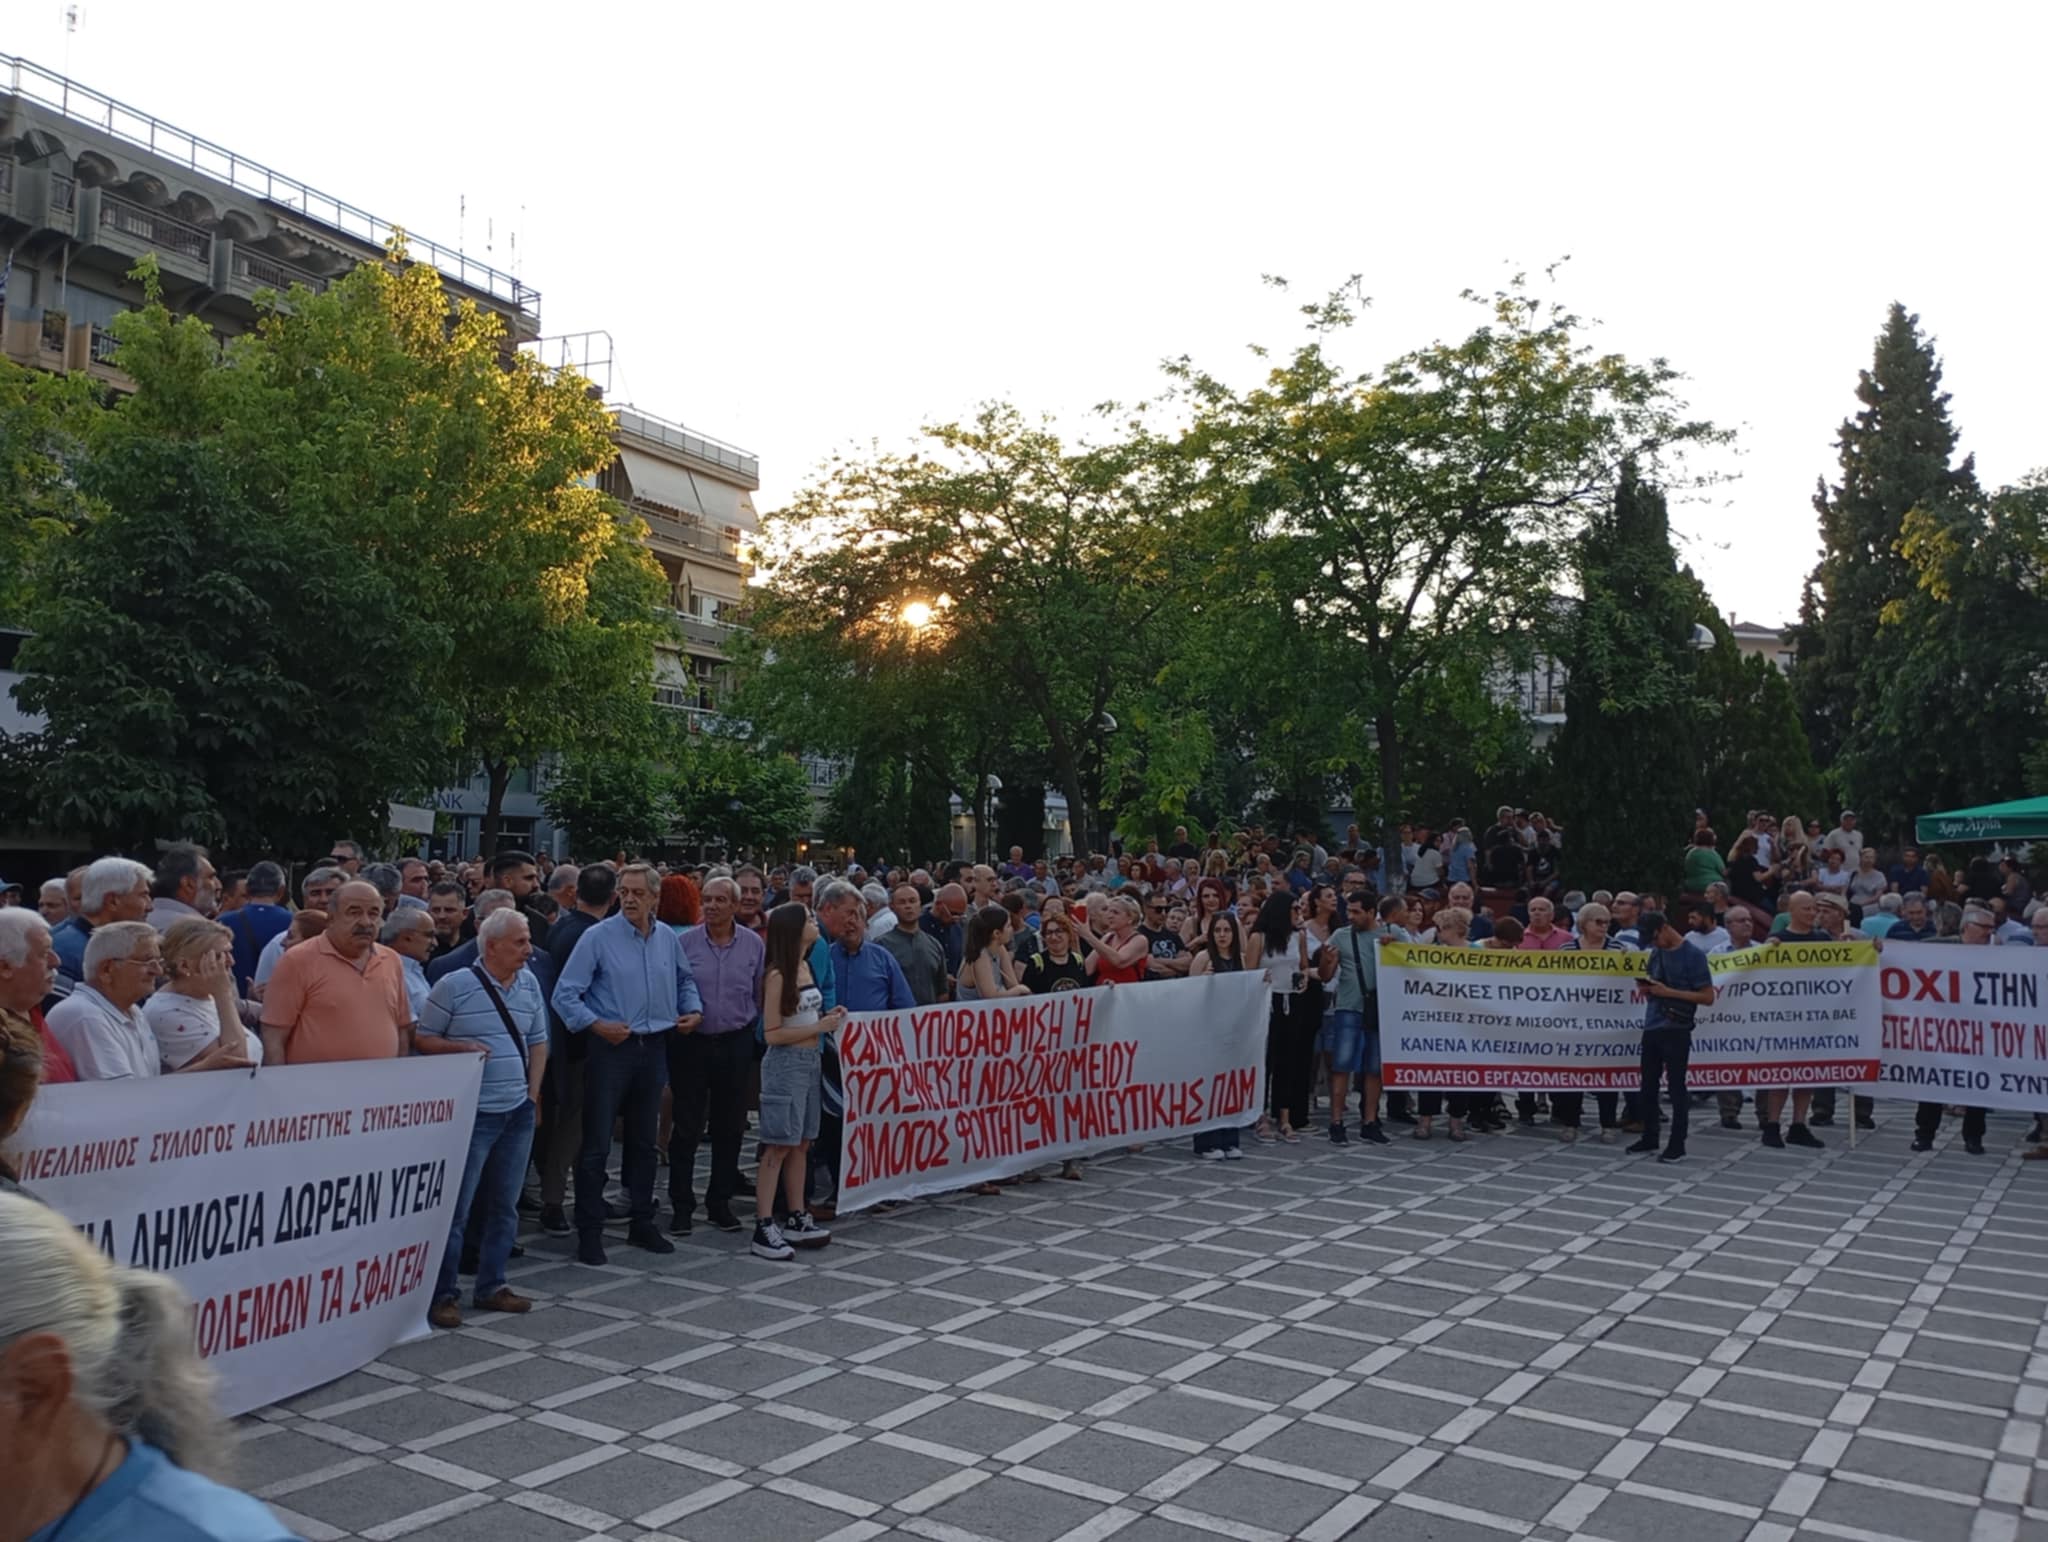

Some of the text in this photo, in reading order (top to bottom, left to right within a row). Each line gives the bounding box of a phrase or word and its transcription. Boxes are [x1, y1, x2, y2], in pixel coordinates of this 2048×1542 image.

[1405, 949, 1532, 969] ΑΠΟΚΛΕΙΣΤΙΚΑ
[1537, 955, 1618, 971] ΔΗΜΟΣΙΑ
[1623, 957, 1634, 971] &
[1709, 953, 1761, 972] ΥΓΕΙΑ
[1765, 949, 1792, 964] ΓΙΑ
[1797, 947, 1854, 963] ΟΛΟΥΣ
[1404, 979, 1493, 1000] ΜΑΖΙΚΕΣ
[1499, 985, 1625, 1004] ΠΡΟΣΛΗΨΕΙΣ
[1727, 979, 1854, 998] ΠΡΟΣΩΠΙΚΟΥ
[1880, 967, 2037, 1008] ΟΧΙ ΣΤΗΝ
[841, 1015, 907, 1068] ΚΑΜΙΑ
[911, 1000, 1065, 1059] ΥΠΟΒΑΘΜΙΣΗ
[1401, 1010, 1464, 1024] ΑΥΞΗΣΕΙΣ
[1468, 1013, 1512, 1027] ΣΤΟΥΣ
[1516, 1016, 1584, 1031] ΜΙΣΘΟΥΣ,
[1586, 1017, 1644, 1030] ΕΠΑΝΑΦ
[1751, 1010, 1803, 1024] ΕΝΤΑΞΗ
[1806, 1009, 1830, 1022] ΣΤΑ
[1833, 1007, 1857, 1021] ΒΑΕ
[1881, 1014, 2048, 1061] ΣΤΕΛΕΧΩΣΗ ΤΟΥ Ν
[1401, 1037, 1467, 1052] ΚΑΝΕΝΑ
[1472, 1039, 1553, 1055] ΚΛΕΙΣΙΜΟ
[1574, 1043, 1644, 1057] ΣΥΓΧΩΝΕ
[1689, 1035, 1859, 1055] ΛΙΝΙΚΩΝ/ΤΜΗΜΑΤΩΝ
[977, 1040, 1138, 1106] ΝΟΣΟΚΟΜΕΙΟΥ
[1394, 1068, 1479, 1085] ΣΩΜΑΤΕΙΟ
[1484, 1070, 1606, 1087] ΕΡΓΑΖΟΜΕΝΩΝ
[1747, 1065, 1867, 1083] ΝΟΣΟΚΟΜΕΙΟΥ
[1878, 1063, 1990, 1091] ΣΩΜΑΤΕΙΟ
[150, 1123, 236, 1162] ΣΥΛΛΟΓΟΣ
[244, 1110, 353, 1148] ΑΛΛΗΛΕΓΓΥΗΣ
[361, 1098, 455, 1134] ΣΥΝΤΑΞΙΟΥΧΩΝ
[955, 1096, 1057, 1163] ΦΟΙΤΗΤΩΝ
[1063, 1077, 1204, 1143] ΜΑΙΕΥΤΙΚΗΣ
[1207, 1066, 1256, 1120] ΠΔΜ
[130, 1191, 265, 1271] ΔΗΜΟΣΙΑ
[273, 1171, 383, 1244] ΔΩΡΕΑΝ
[391, 1159, 447, 1219] ΥΓΕΙΑ
[319, 1265, 344, 1324] ΤΑ
[349, 1241, 431, 1316] ΣΦΑΓΕΙΑ
